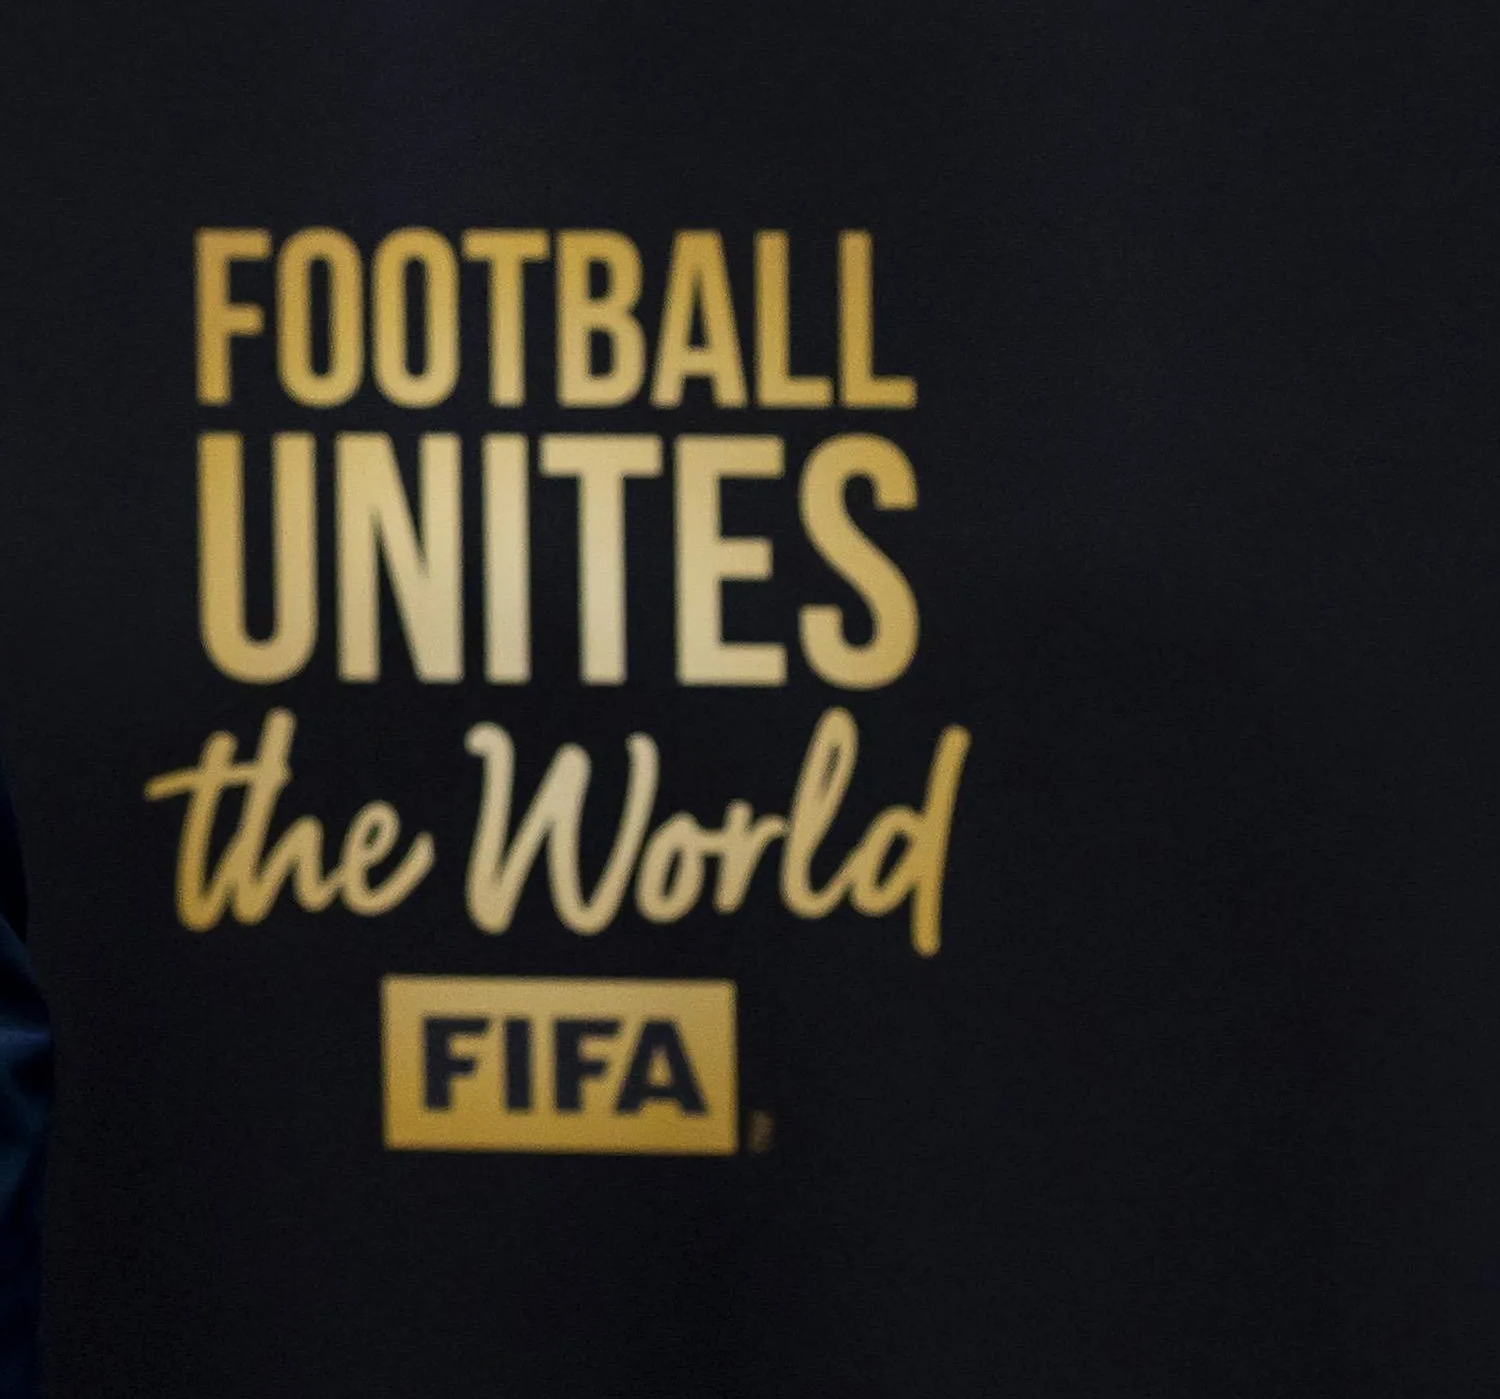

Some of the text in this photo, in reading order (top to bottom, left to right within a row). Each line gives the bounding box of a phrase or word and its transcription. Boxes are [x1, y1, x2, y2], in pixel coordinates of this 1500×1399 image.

[195, 227, 917, 409] FOOTBALL
[197, 431, 919, 689] UNITES
[146, 707, 970, 955] the World
[419, 1013, 711, 1120] FIFA
